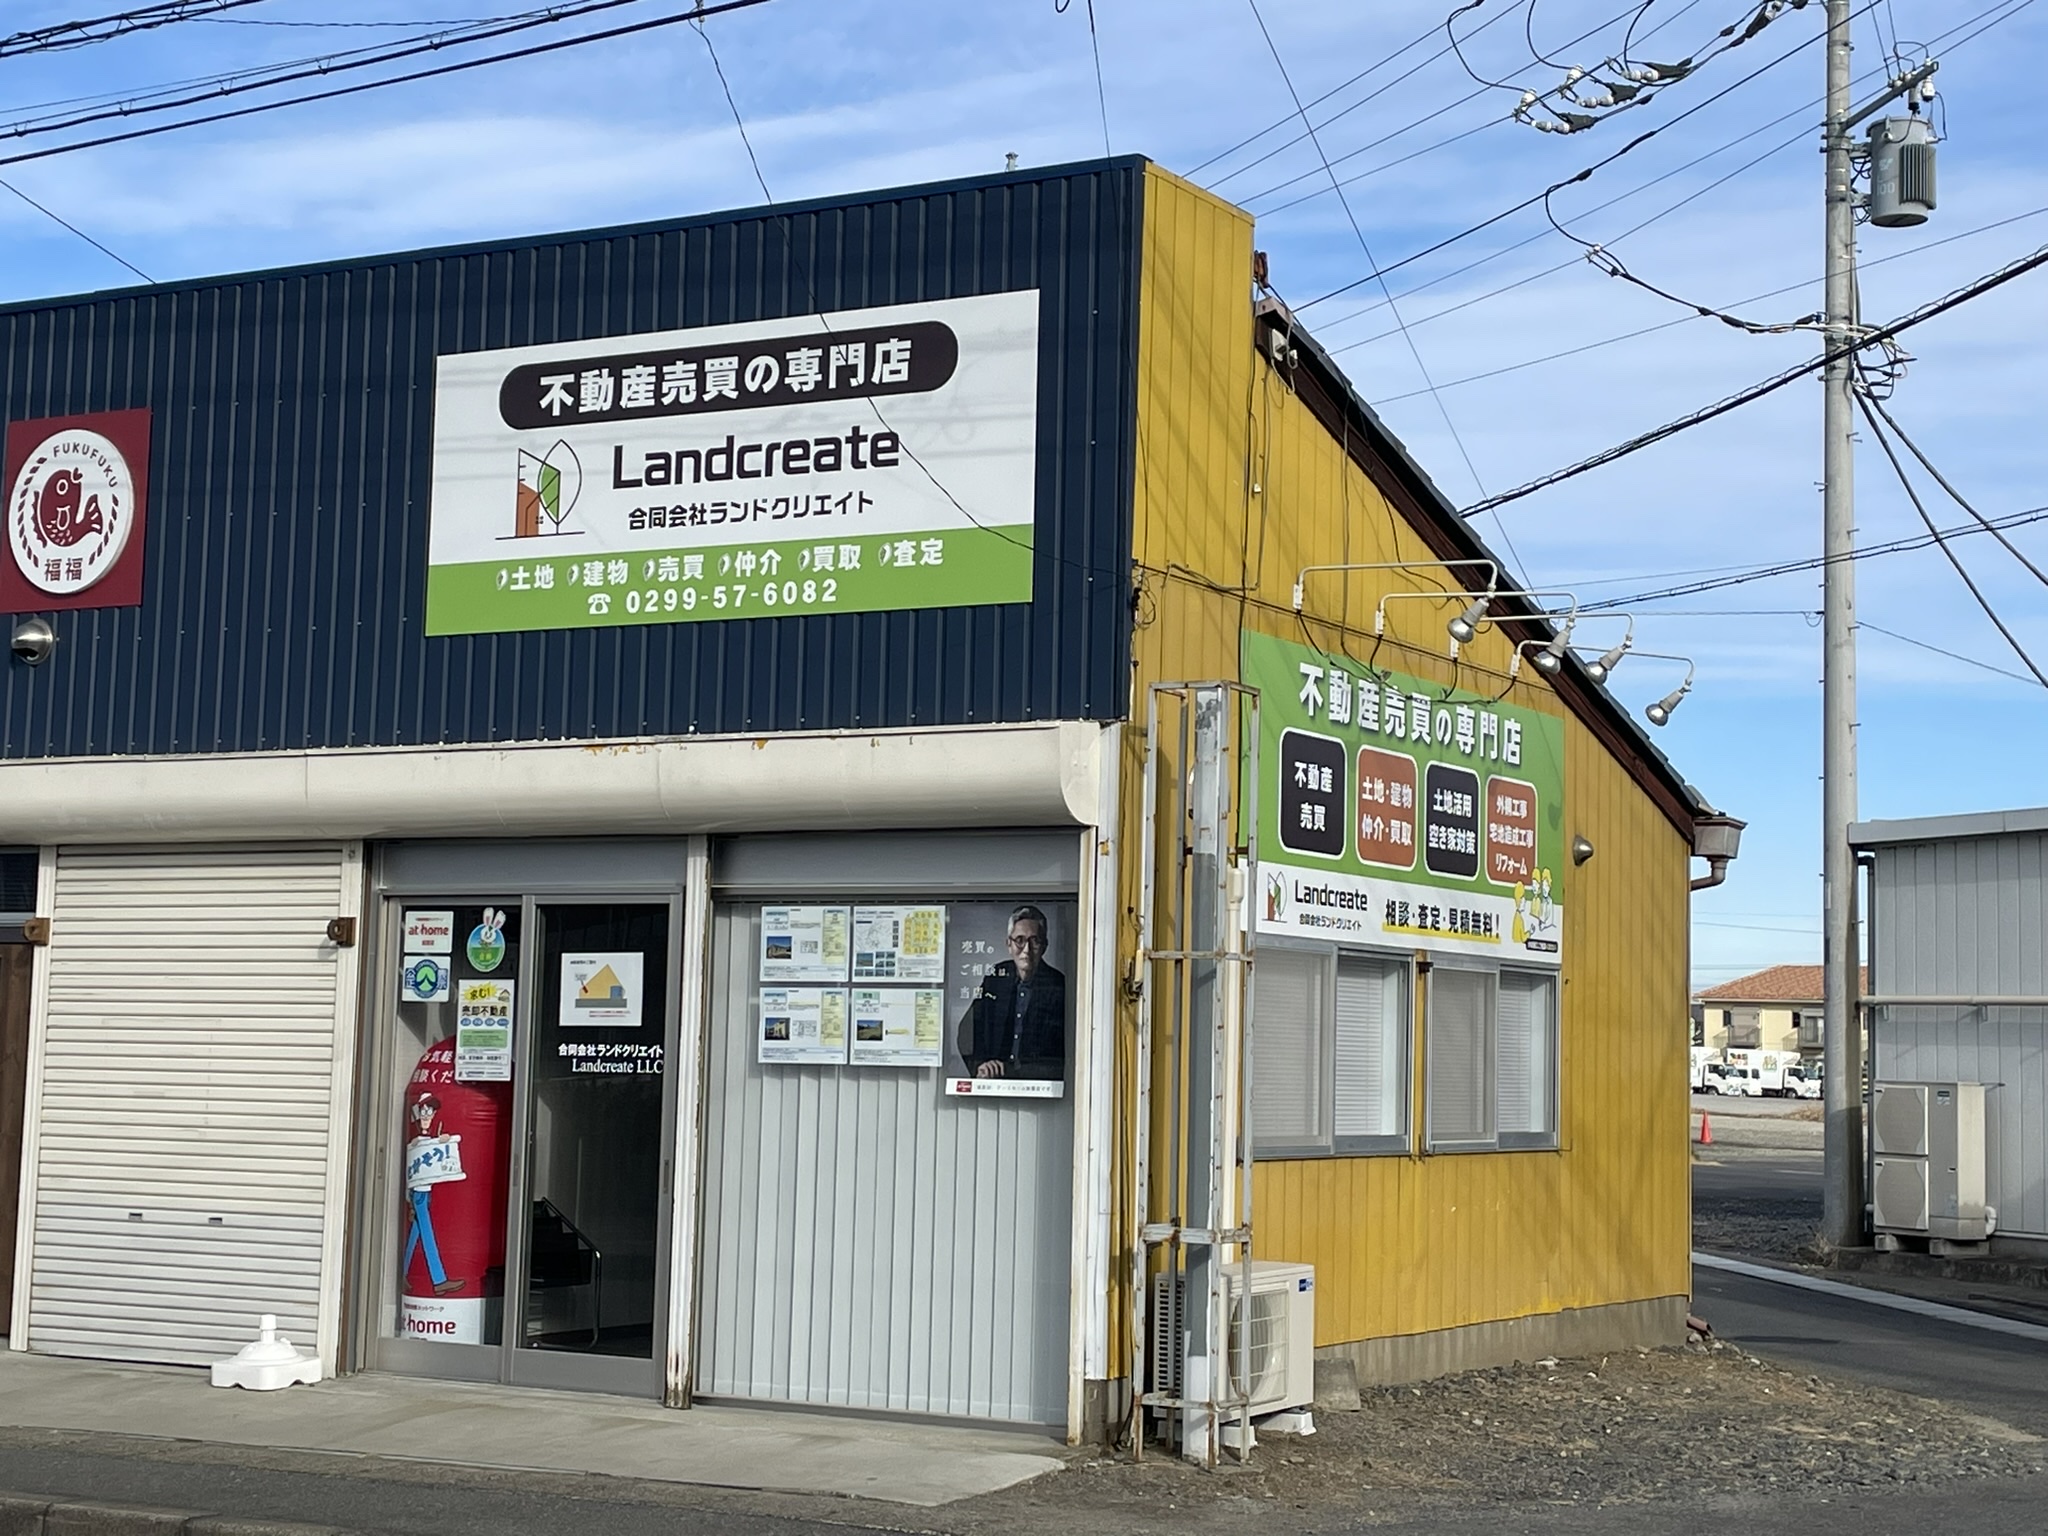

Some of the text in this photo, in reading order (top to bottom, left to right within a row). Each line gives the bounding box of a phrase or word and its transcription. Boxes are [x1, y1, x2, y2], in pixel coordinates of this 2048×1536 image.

[538, 338, 913, 417] 不動産売買の専門店
[53, 442, 118, 488] FUKUFUKU
[613, 425, 899, 489] Landcreate
[628, 491, 874, 531] 合同会社ランドクリエイト
[44, 558, 83, 581] 福福
[510, 538, 944, 591] 土地 建物 売買 仲介 買取 査定
[626, 579, 838, 614] 0299-57-6082
[1299, 662, 1522, 765] 不動産売買の専門店
[1294, 761, 1333, 793] 不動産
[1362, 776, 1413, 809] 土地・建物
[1300, 802, 1325, 832] 売買
[1433, 788, 1472, 818] 土地活用
[1429, 823, 1476, 855] 空き家対策
[1496, 853, 1528, 875] リフォーム
[1295, 880, 1368, 911] Landcreate
[408, 923, 449, 936] at home
[1299, 913, 1362, 931] 合同会社ランドクリエイト
[462, 1005, 507, 1016] 売却不動産
[558, 1043, 663, 1058] 合同会社ランドクリエイト
[572, 1058, 664, 1073] Landcreate LLC
[408, 1313, 456, 1334] home
